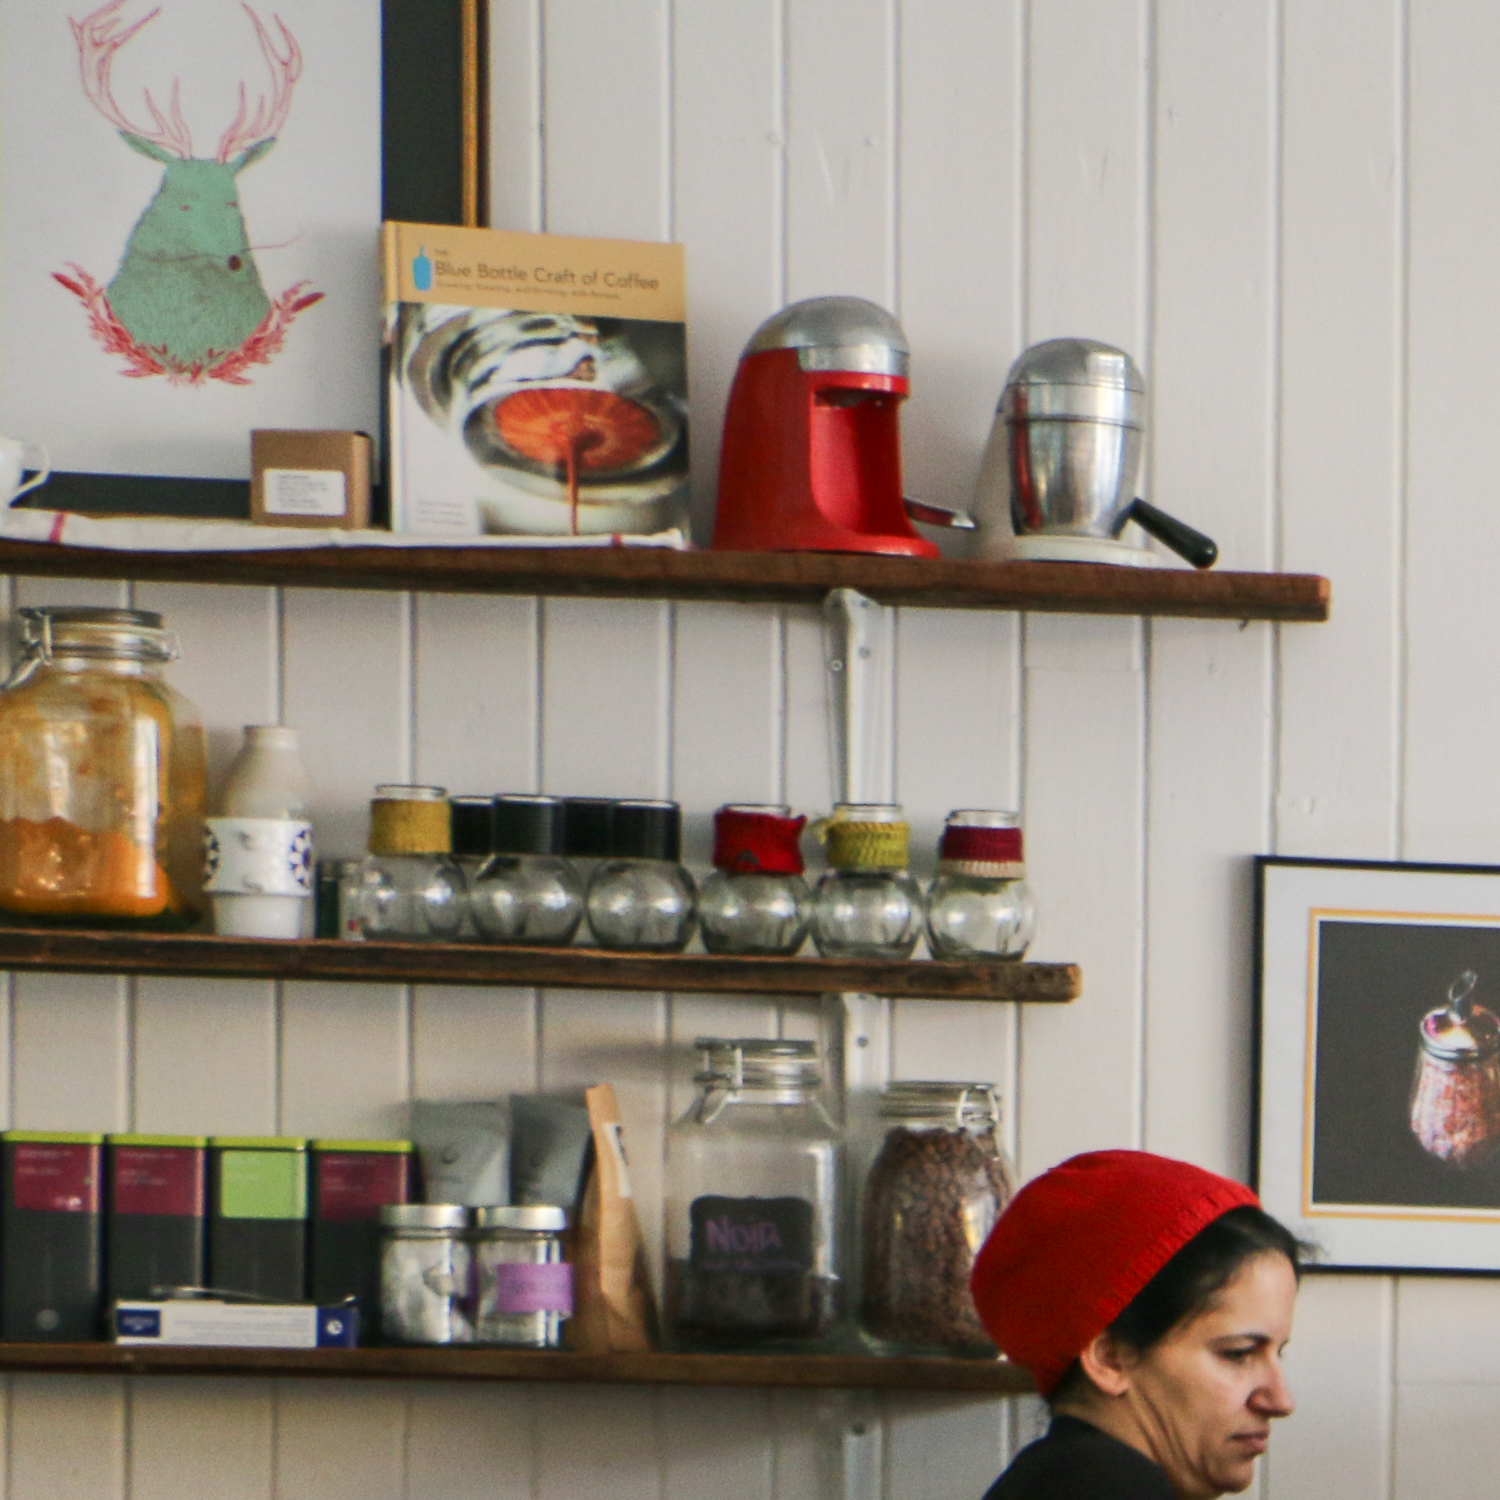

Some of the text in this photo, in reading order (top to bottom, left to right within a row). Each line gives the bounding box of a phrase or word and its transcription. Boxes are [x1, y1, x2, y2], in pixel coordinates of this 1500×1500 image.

[435, 261, 471, 278] Blue
[477, 264, 528, 283] Bottle
[534, 267, 577, 286] Craft
[603, 272, 660, 291] Coffee
